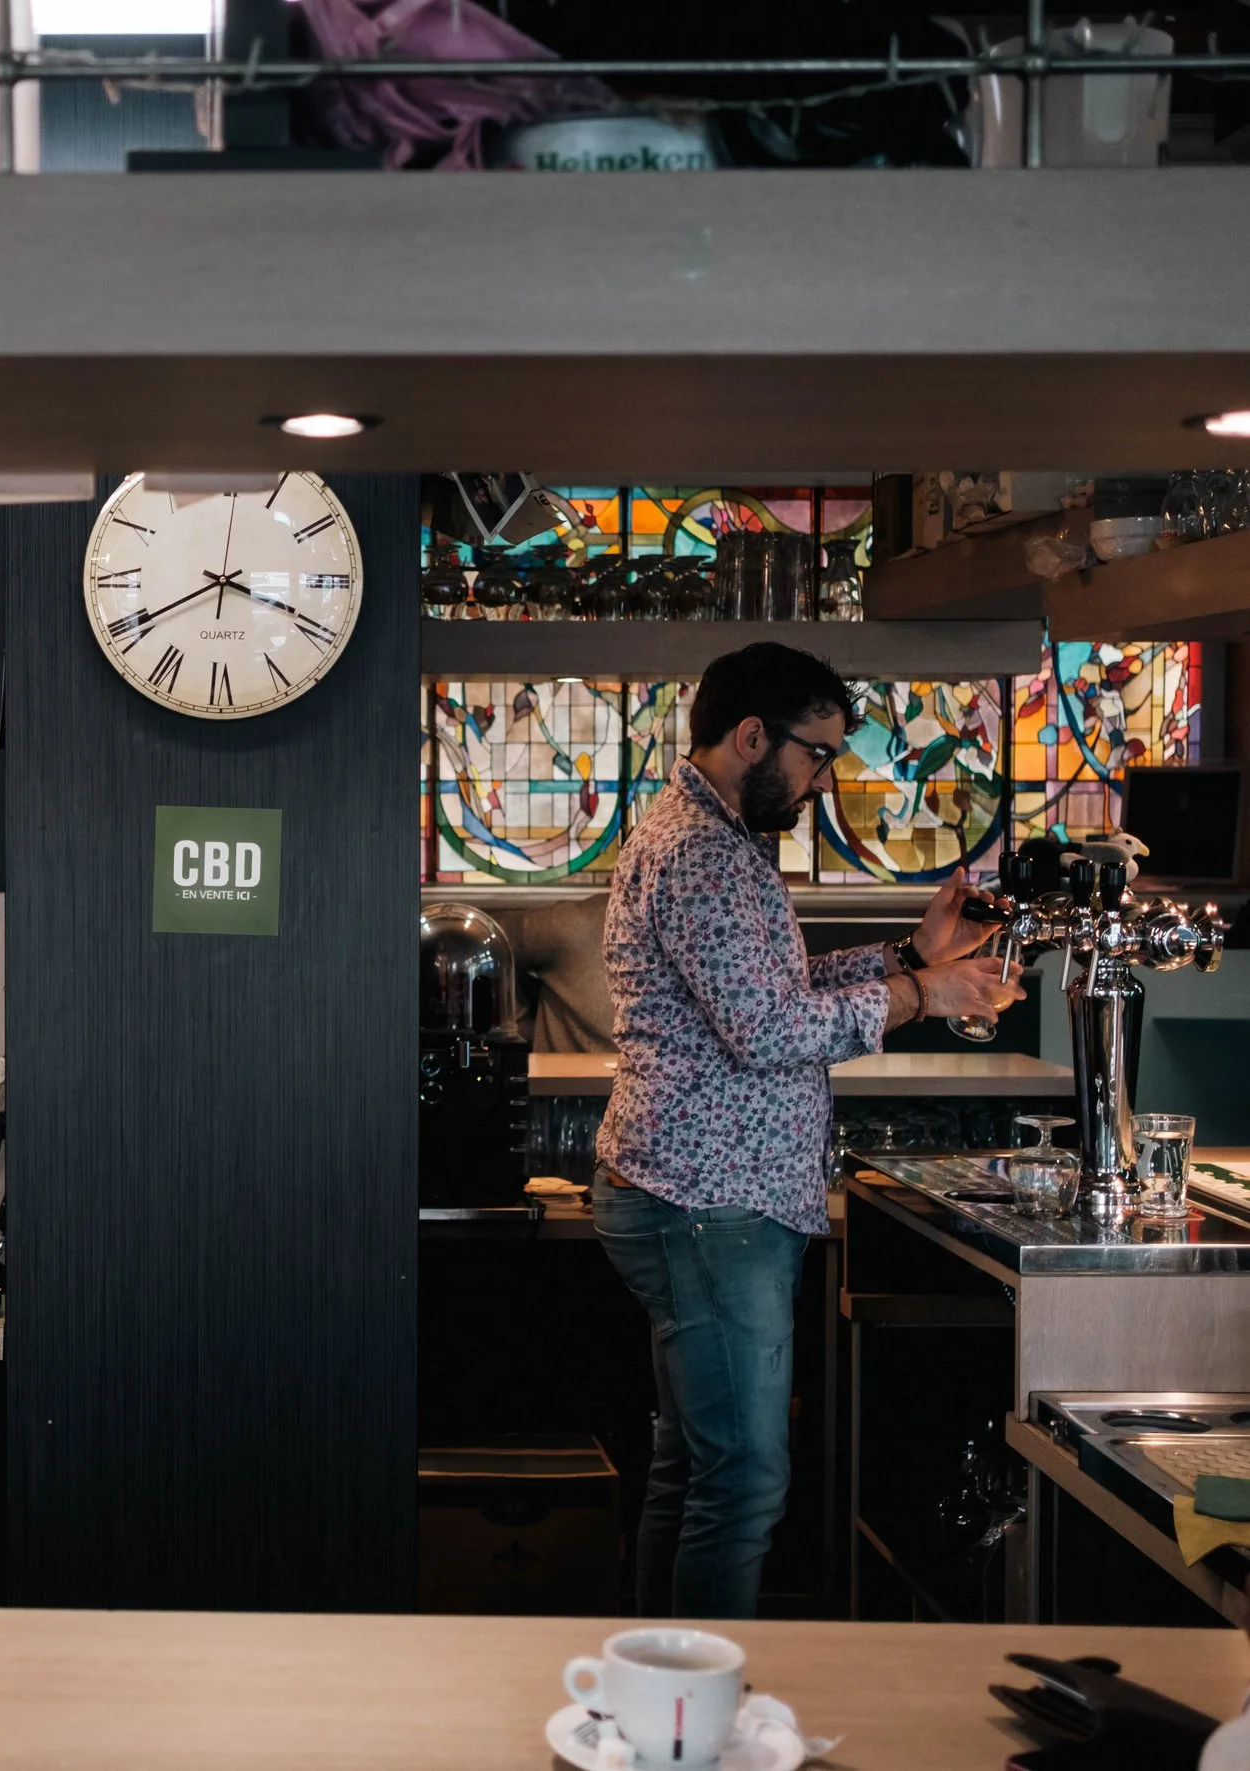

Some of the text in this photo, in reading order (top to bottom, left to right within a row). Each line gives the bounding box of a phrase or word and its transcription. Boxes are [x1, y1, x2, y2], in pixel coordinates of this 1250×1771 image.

[200, 630, 245, 640] QUARTZ
[173, 840, 261, 887] CBD
[182, 889, 251, 900] EN VENTE ICI
